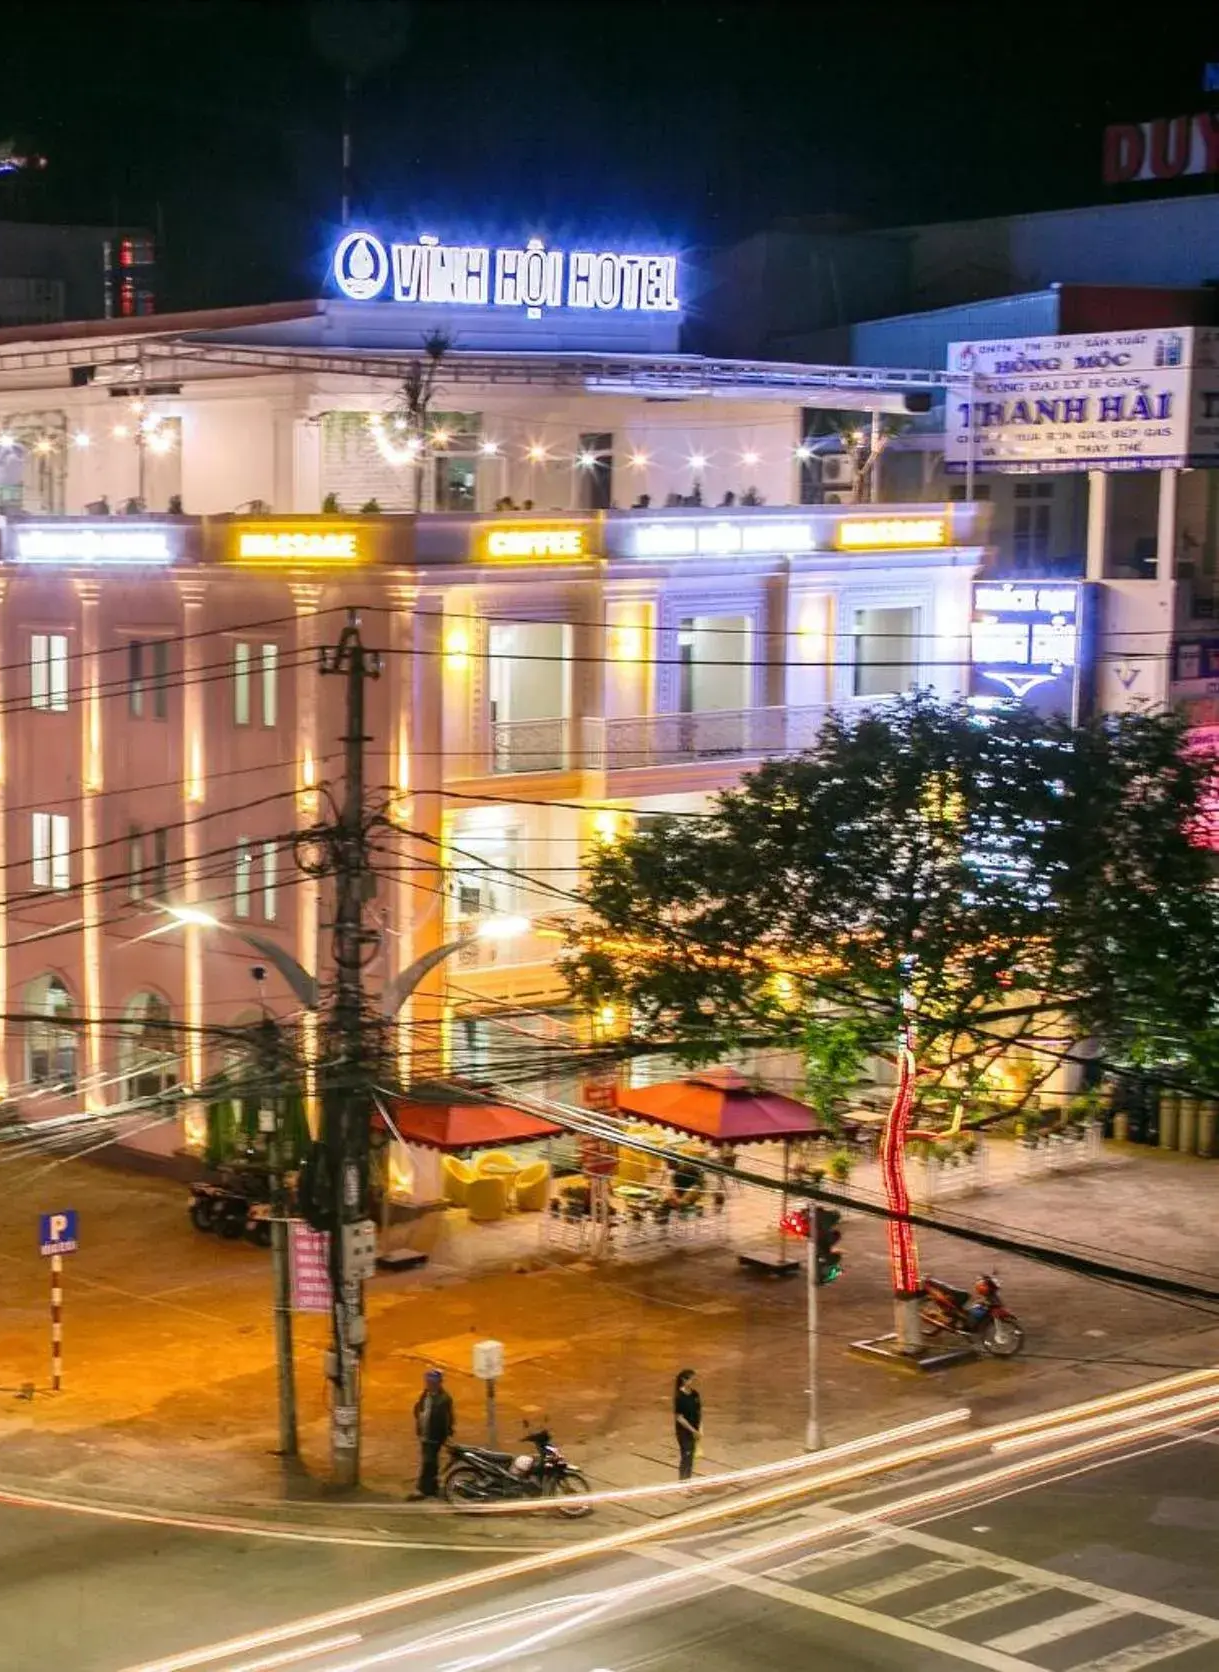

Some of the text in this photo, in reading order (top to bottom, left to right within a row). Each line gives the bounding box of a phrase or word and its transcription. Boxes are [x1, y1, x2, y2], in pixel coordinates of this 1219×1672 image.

[391, 232, 680, 320] VĨNH HỘI HOTEL
[50, 1214, 69, 1241] P
